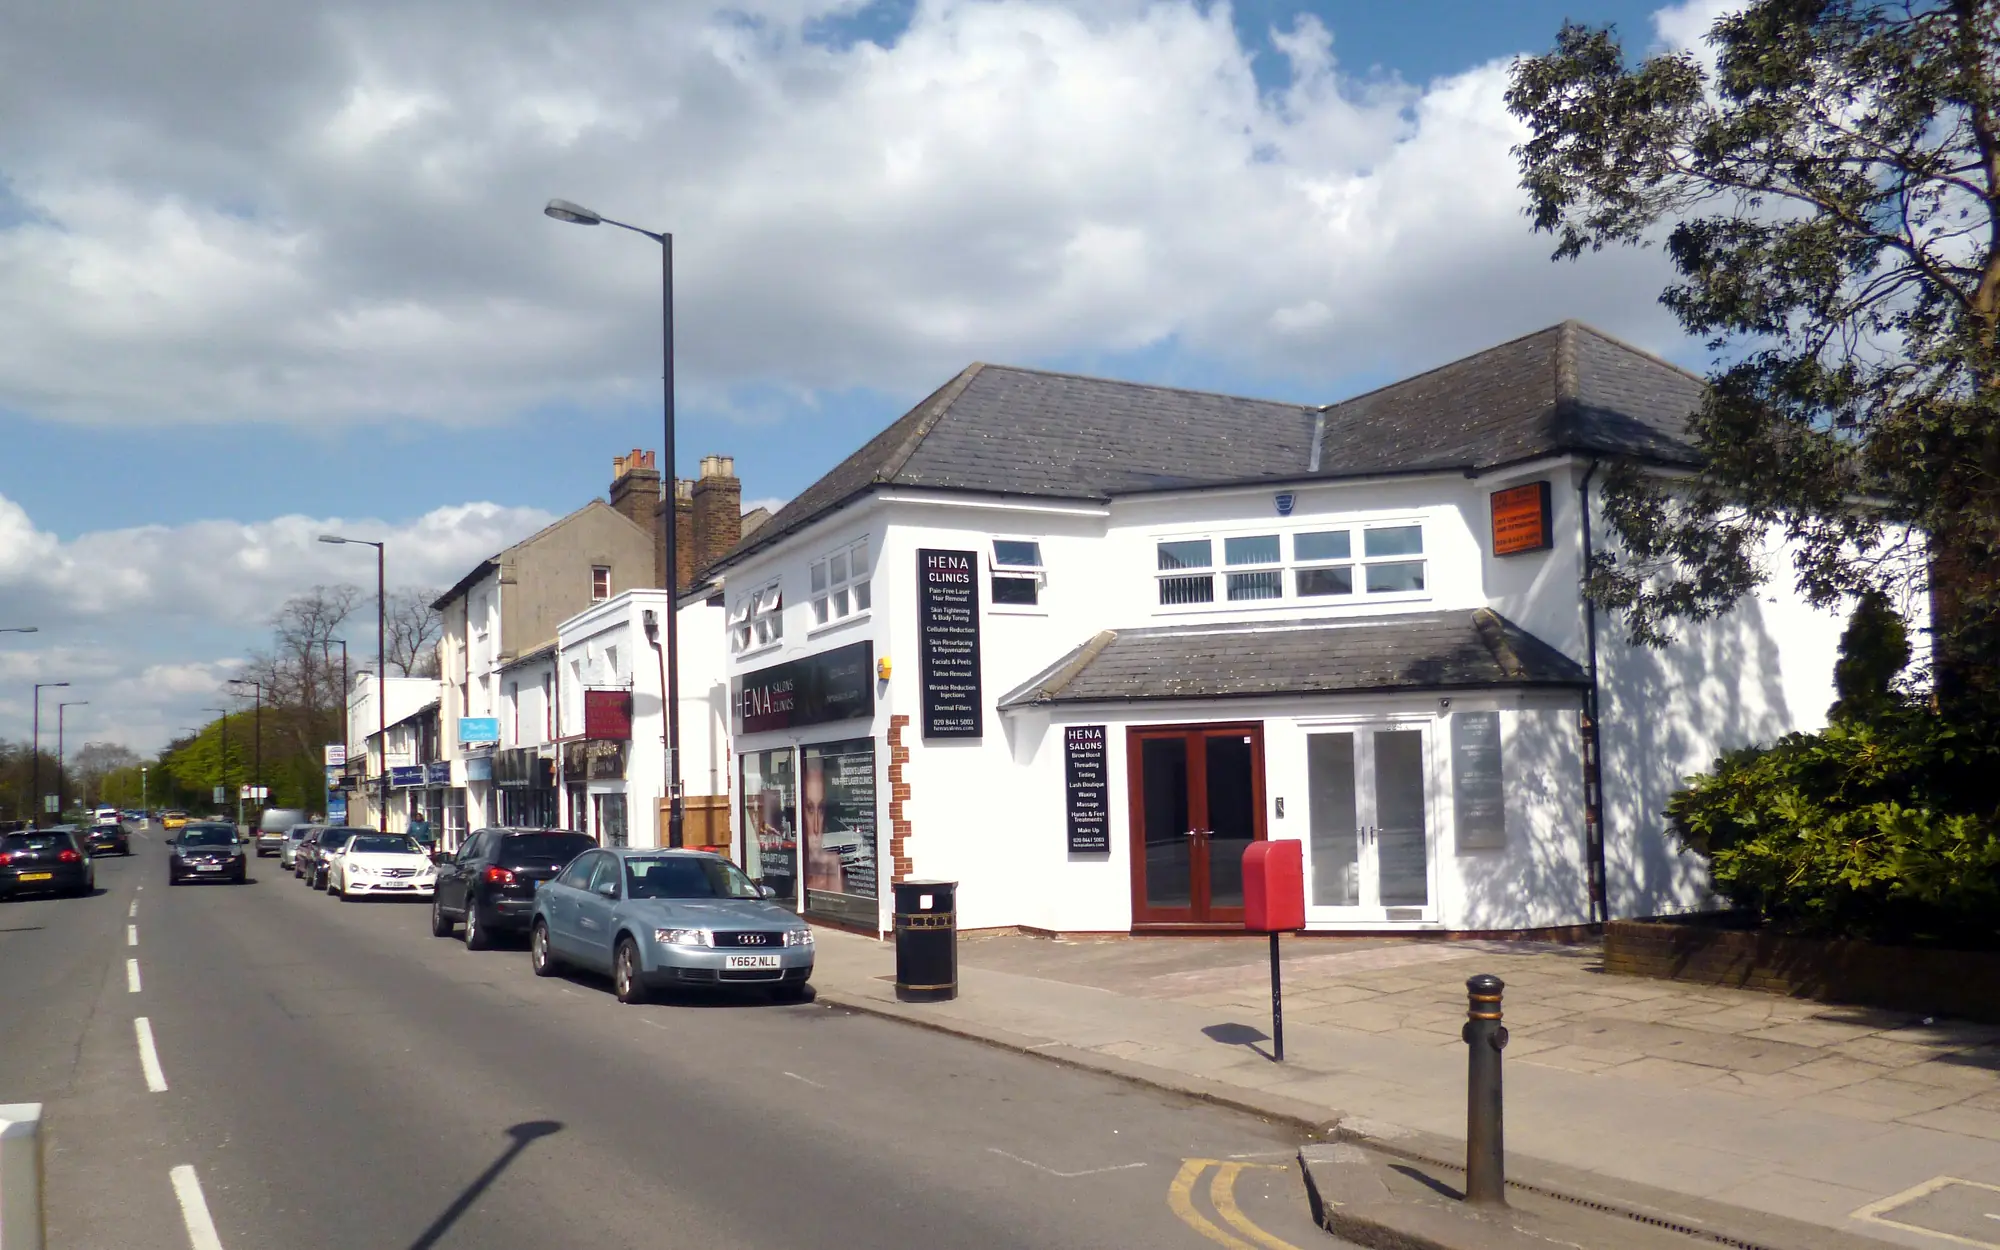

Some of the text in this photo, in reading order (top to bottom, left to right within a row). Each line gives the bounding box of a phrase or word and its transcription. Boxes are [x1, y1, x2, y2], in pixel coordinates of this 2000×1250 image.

[928, 556, 968, 569] HENA
[928, 572, 970, 583] CLINICS
[944, 607, 970, 615] Tightening
[942, 639, 973, 647] Resurfacing
[735, 680, 794, 718] HENA SALONS
[773, 698, 794, 712] CLINICS
[1068, 729, 1102, 740] HENA
[1069, 742, 1102, 750] SALONS
[731, 956, 776, 966] Y662 NLL
